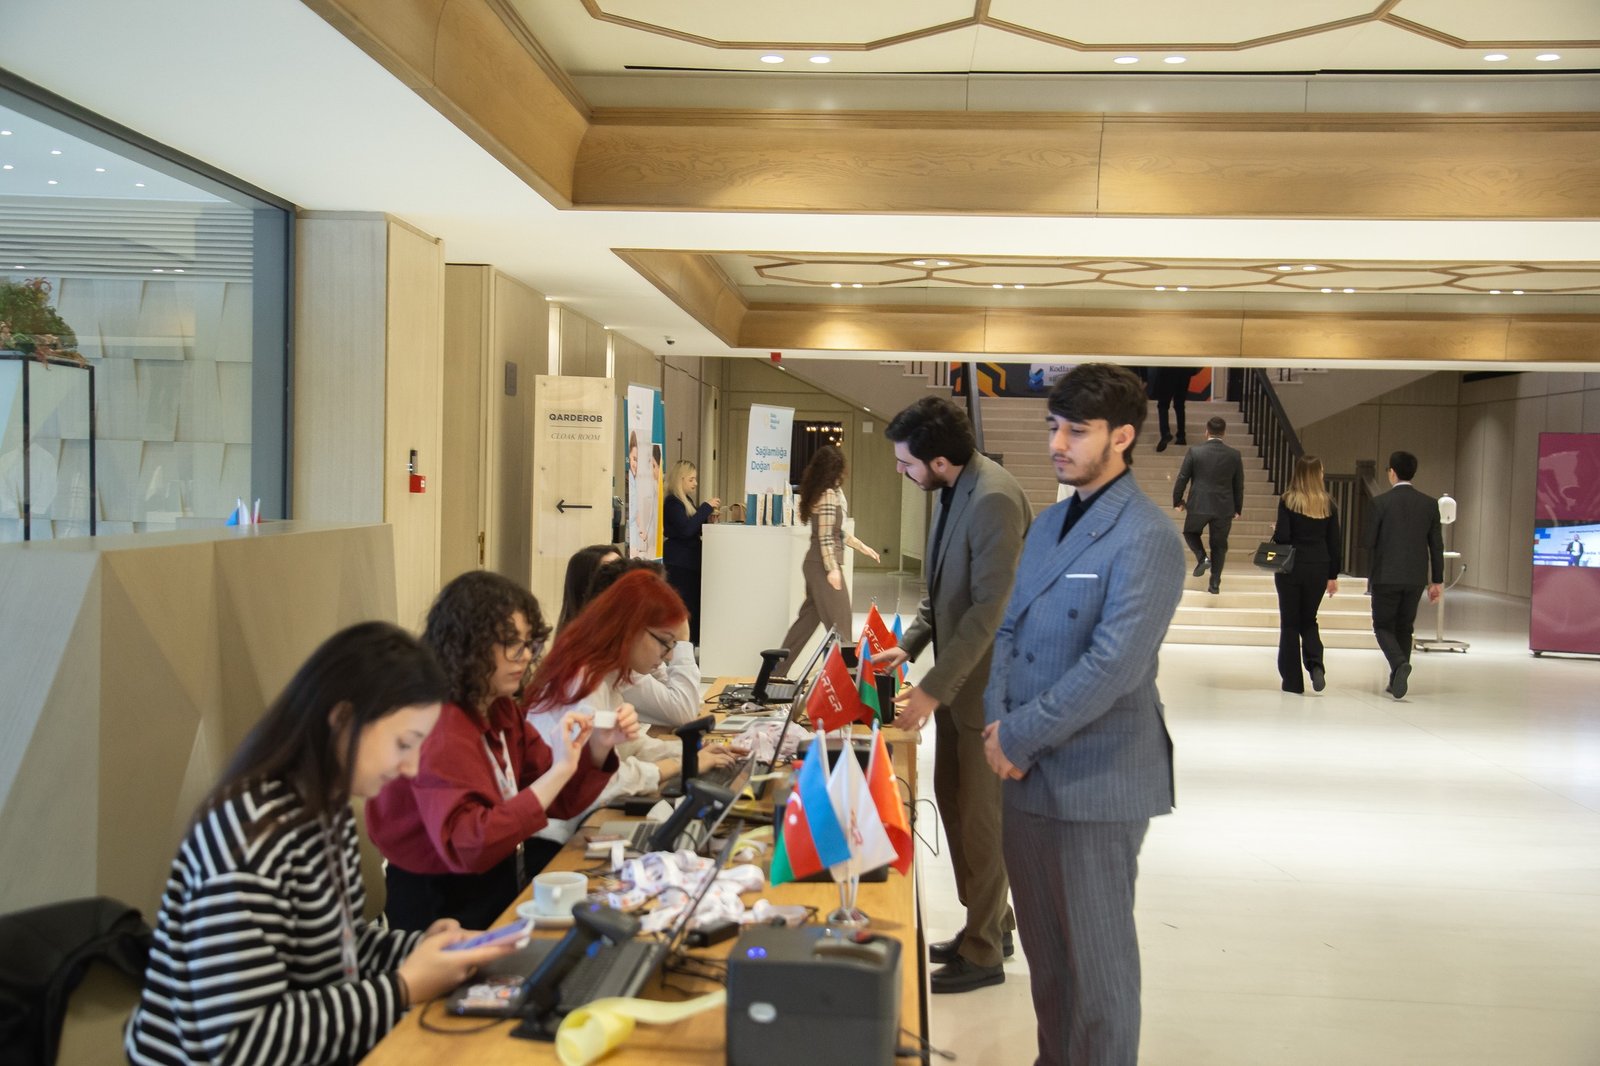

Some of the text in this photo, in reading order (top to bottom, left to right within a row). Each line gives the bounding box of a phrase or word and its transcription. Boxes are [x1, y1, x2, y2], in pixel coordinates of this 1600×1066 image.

[549, 413, 603, 422] QARDEROB
[551, 432, 600, 441] CLOAK ROOM
